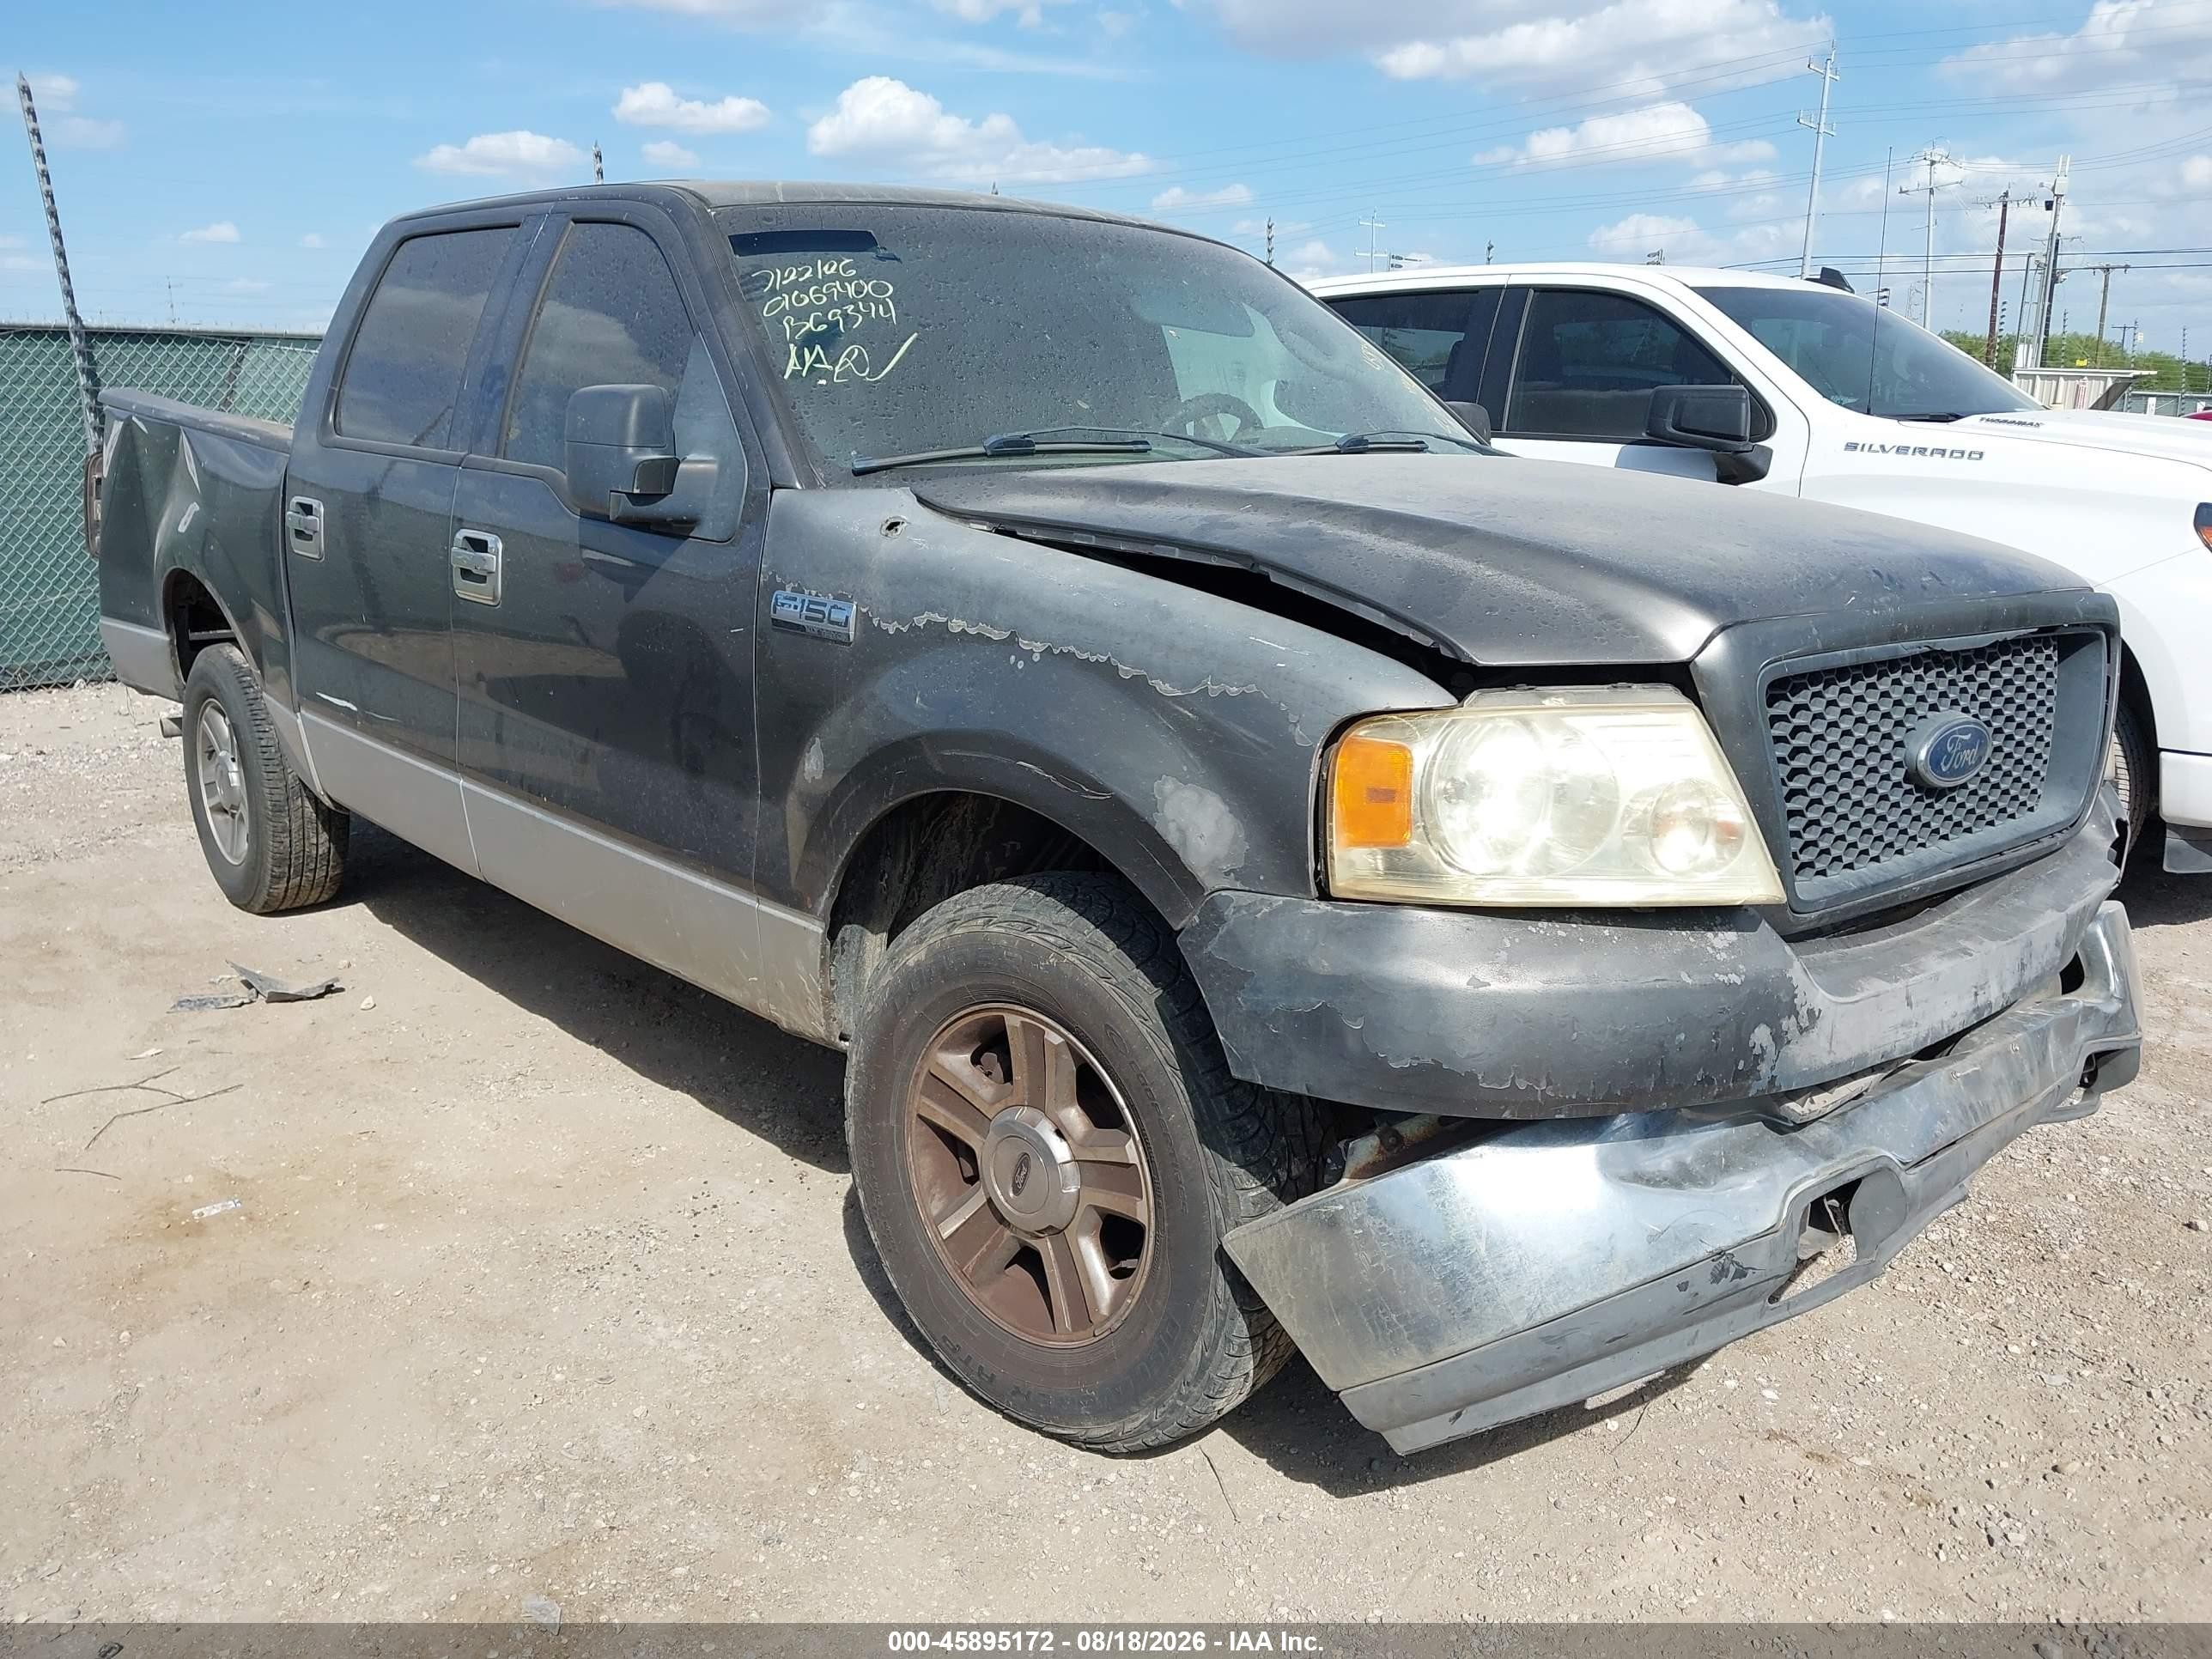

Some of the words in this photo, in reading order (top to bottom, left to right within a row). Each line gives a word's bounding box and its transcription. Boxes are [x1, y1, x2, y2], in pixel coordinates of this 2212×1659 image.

[1844, 441, 1986, 461] SILVERADO
[1940, 732, 1981, 772] Ford
[1015, 1164, 1028, 1190] Ford
